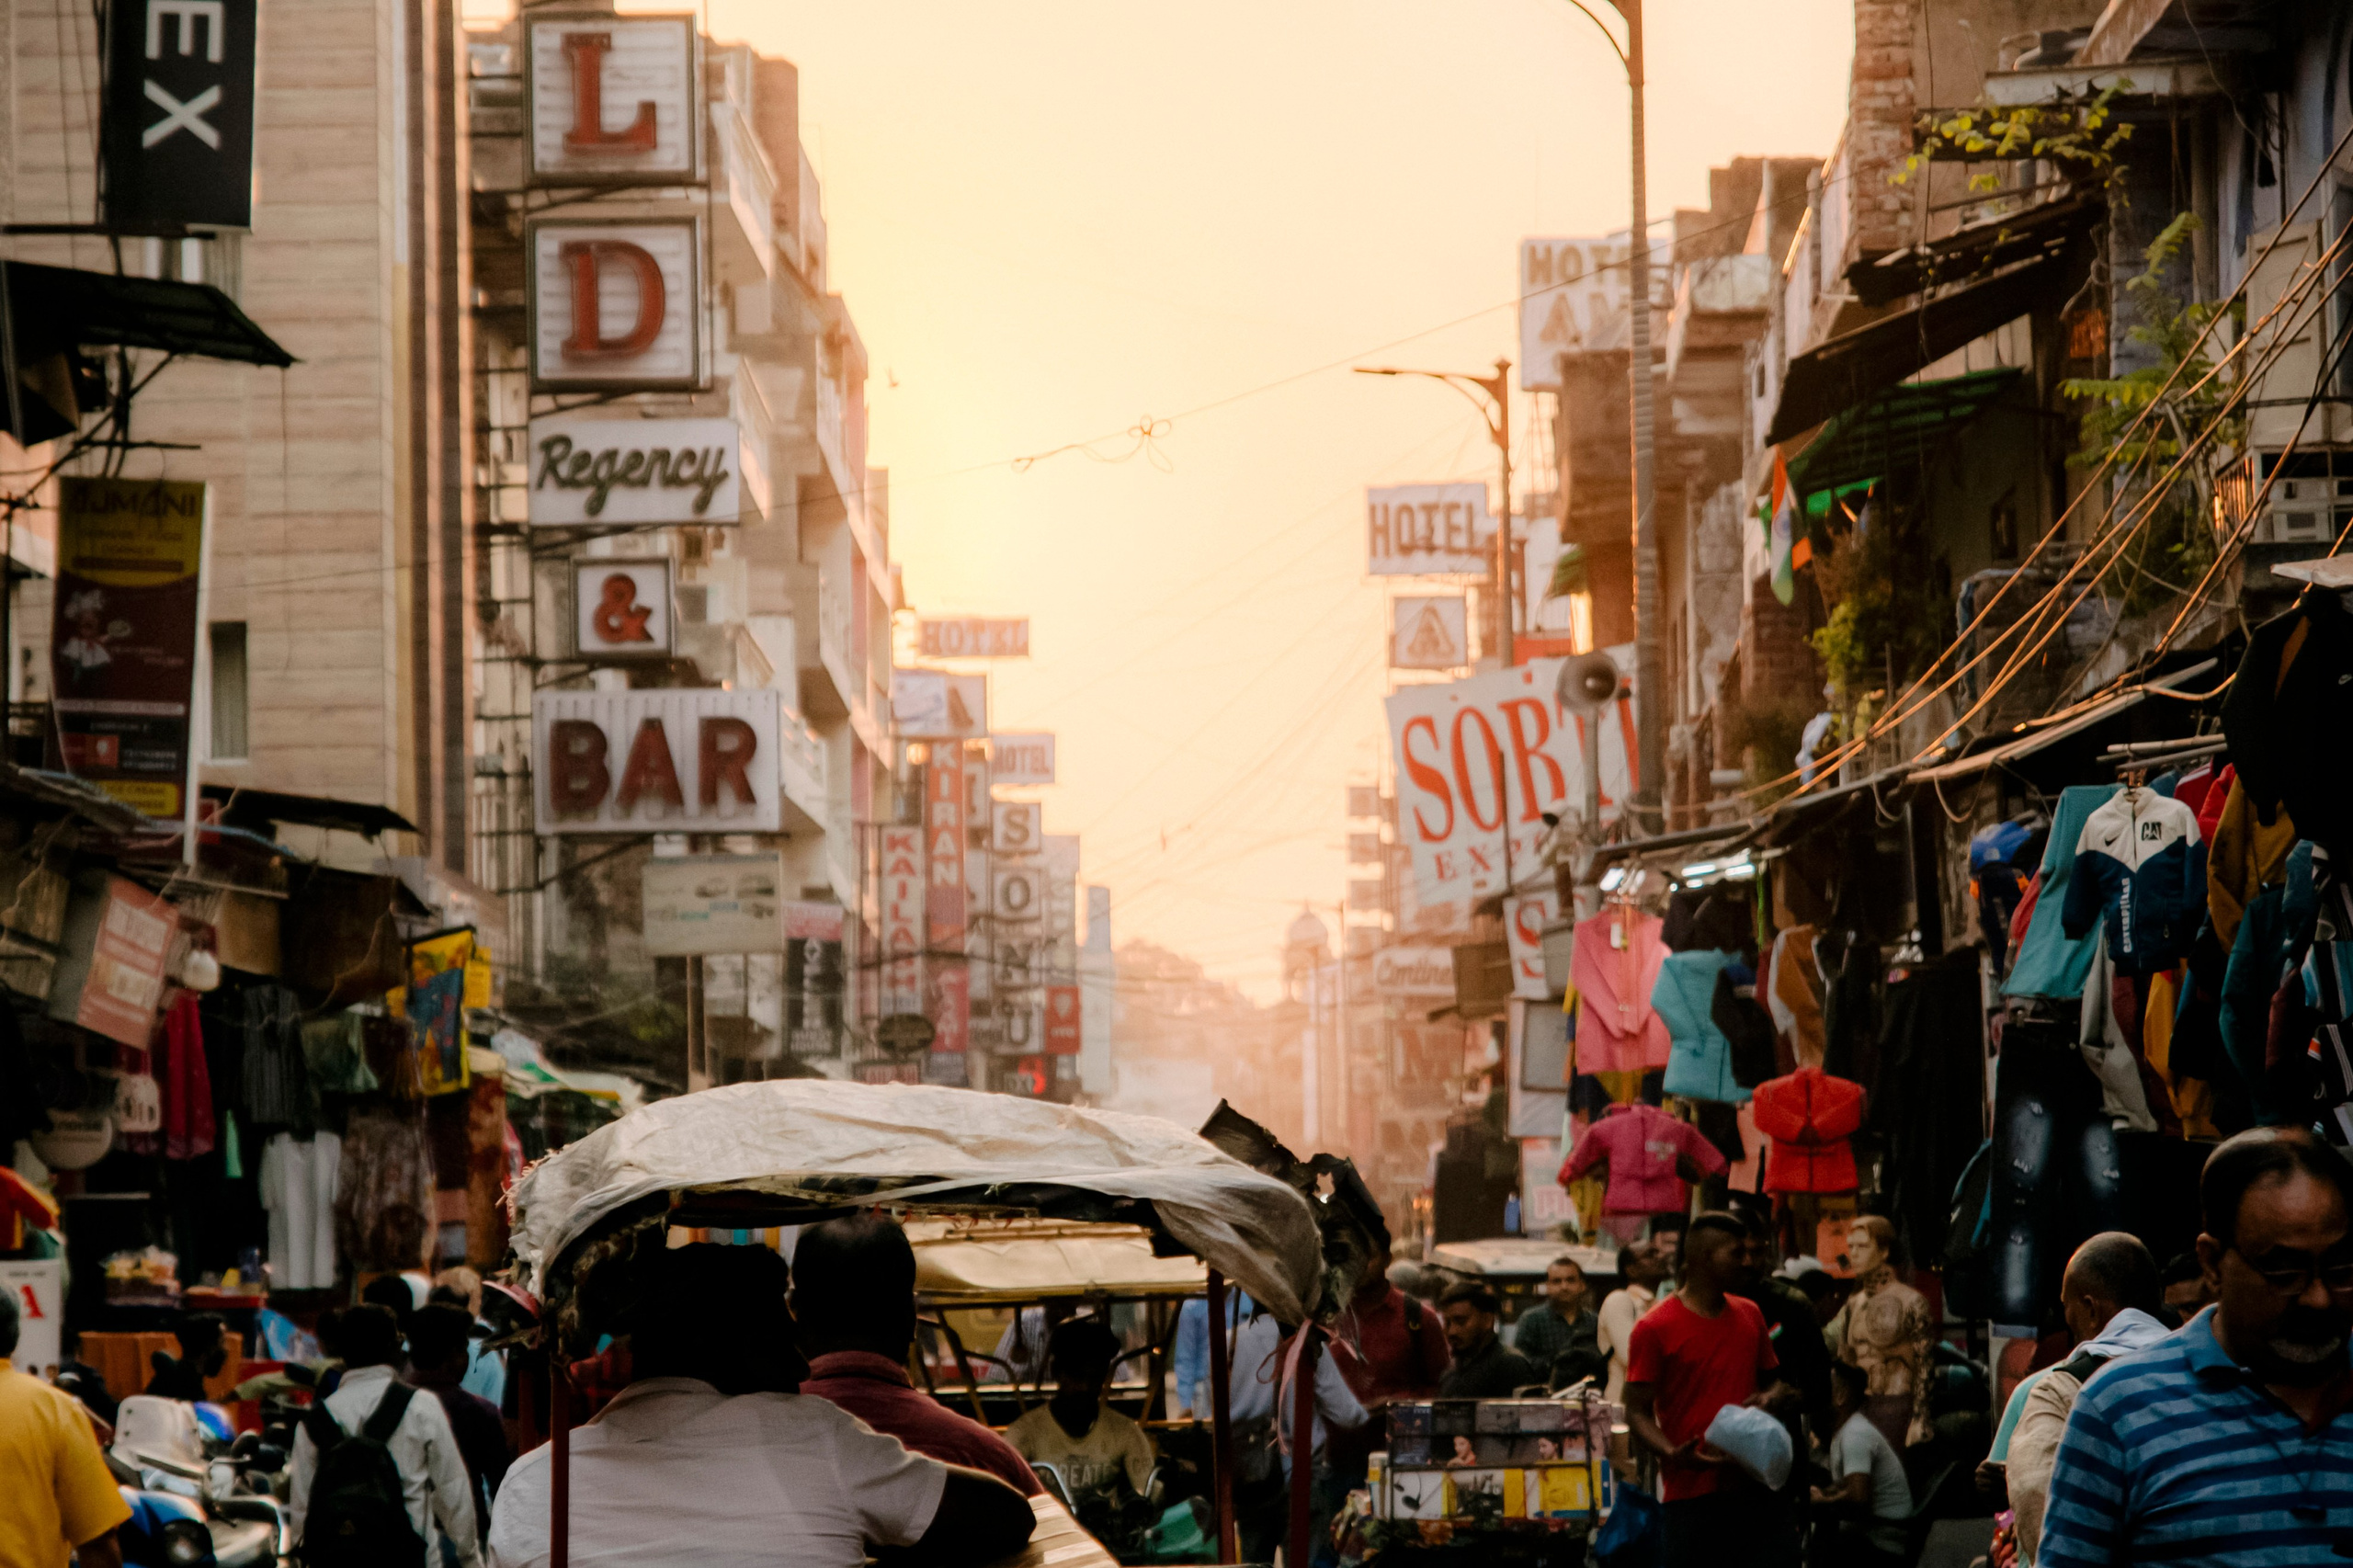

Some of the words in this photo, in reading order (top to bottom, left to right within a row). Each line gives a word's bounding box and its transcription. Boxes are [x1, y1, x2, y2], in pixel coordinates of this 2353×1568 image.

[1527, 243, 1645, 287] HOTE
[536, 434, 729, 517] Regency
[1369, 499, 1485, 559] HOTEL
[593, 573, 654, 642] &
[922, 619, 1028, 655] HOTEL
[550, 717, 757, 815] BAR
[931, 740, 959, 886] KIRAN
[2141, 821, 2162, 841] CAT
